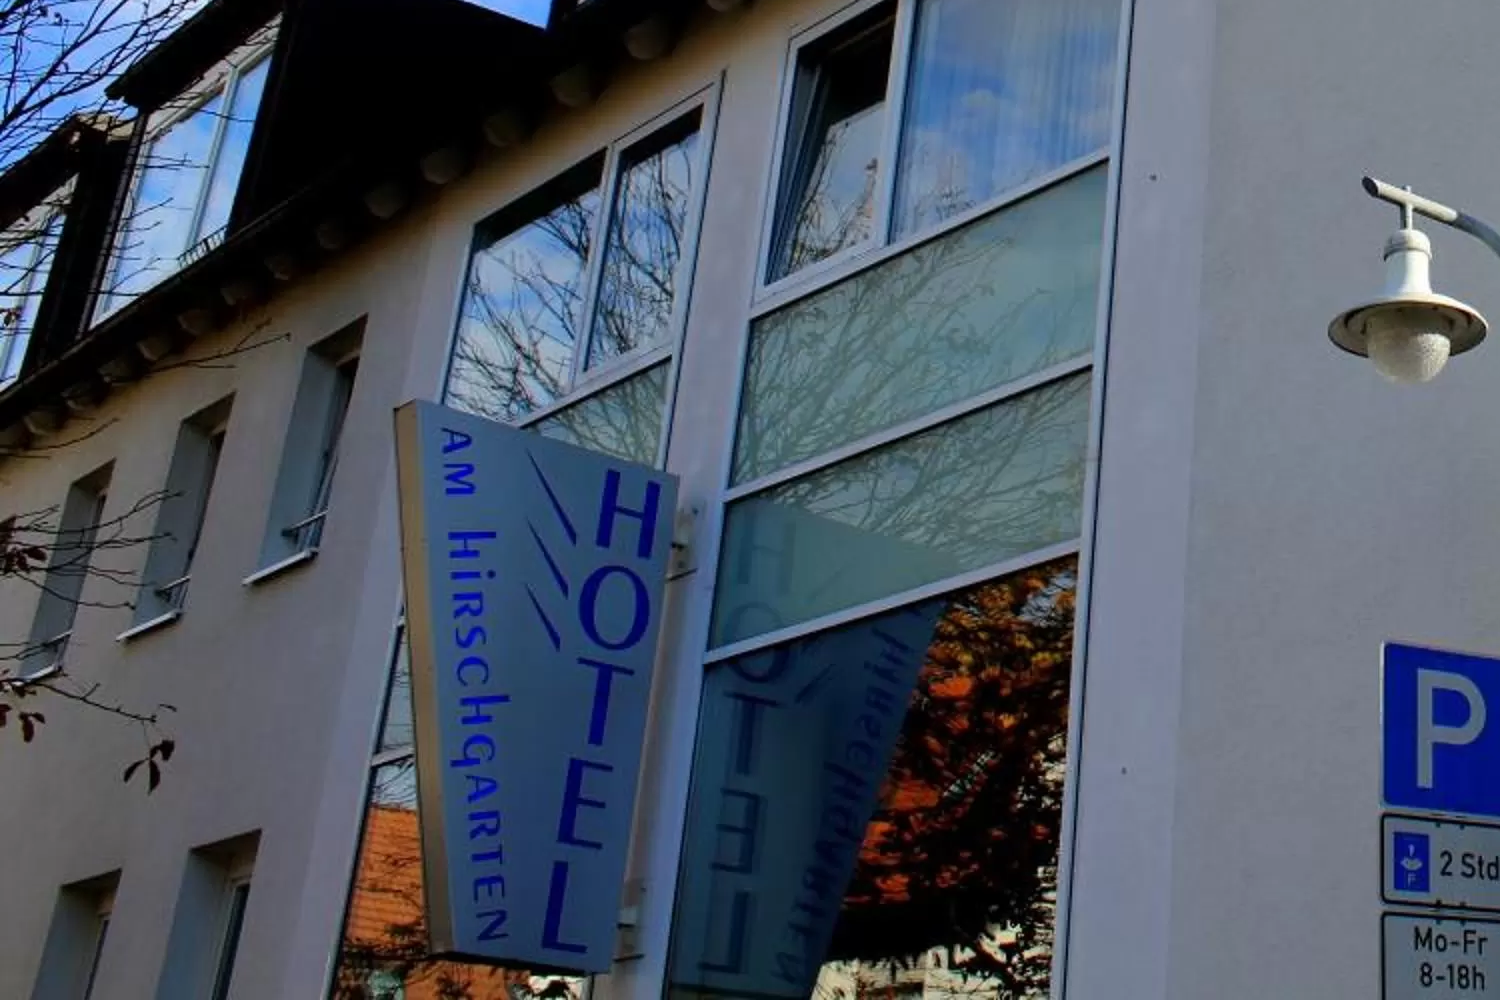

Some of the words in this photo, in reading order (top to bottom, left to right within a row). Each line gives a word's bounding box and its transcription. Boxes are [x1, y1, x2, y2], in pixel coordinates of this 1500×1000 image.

[440, 427, 477, 496] AM
[541, 469, 661, 954] HOTEL
[1416, 667, 1488, 790] P
[1439, 850, 1454, 877] 2
[1413, 926, 1488, 955] Mo-Fr
[1420, 962, 1486, 991] 8-18h
